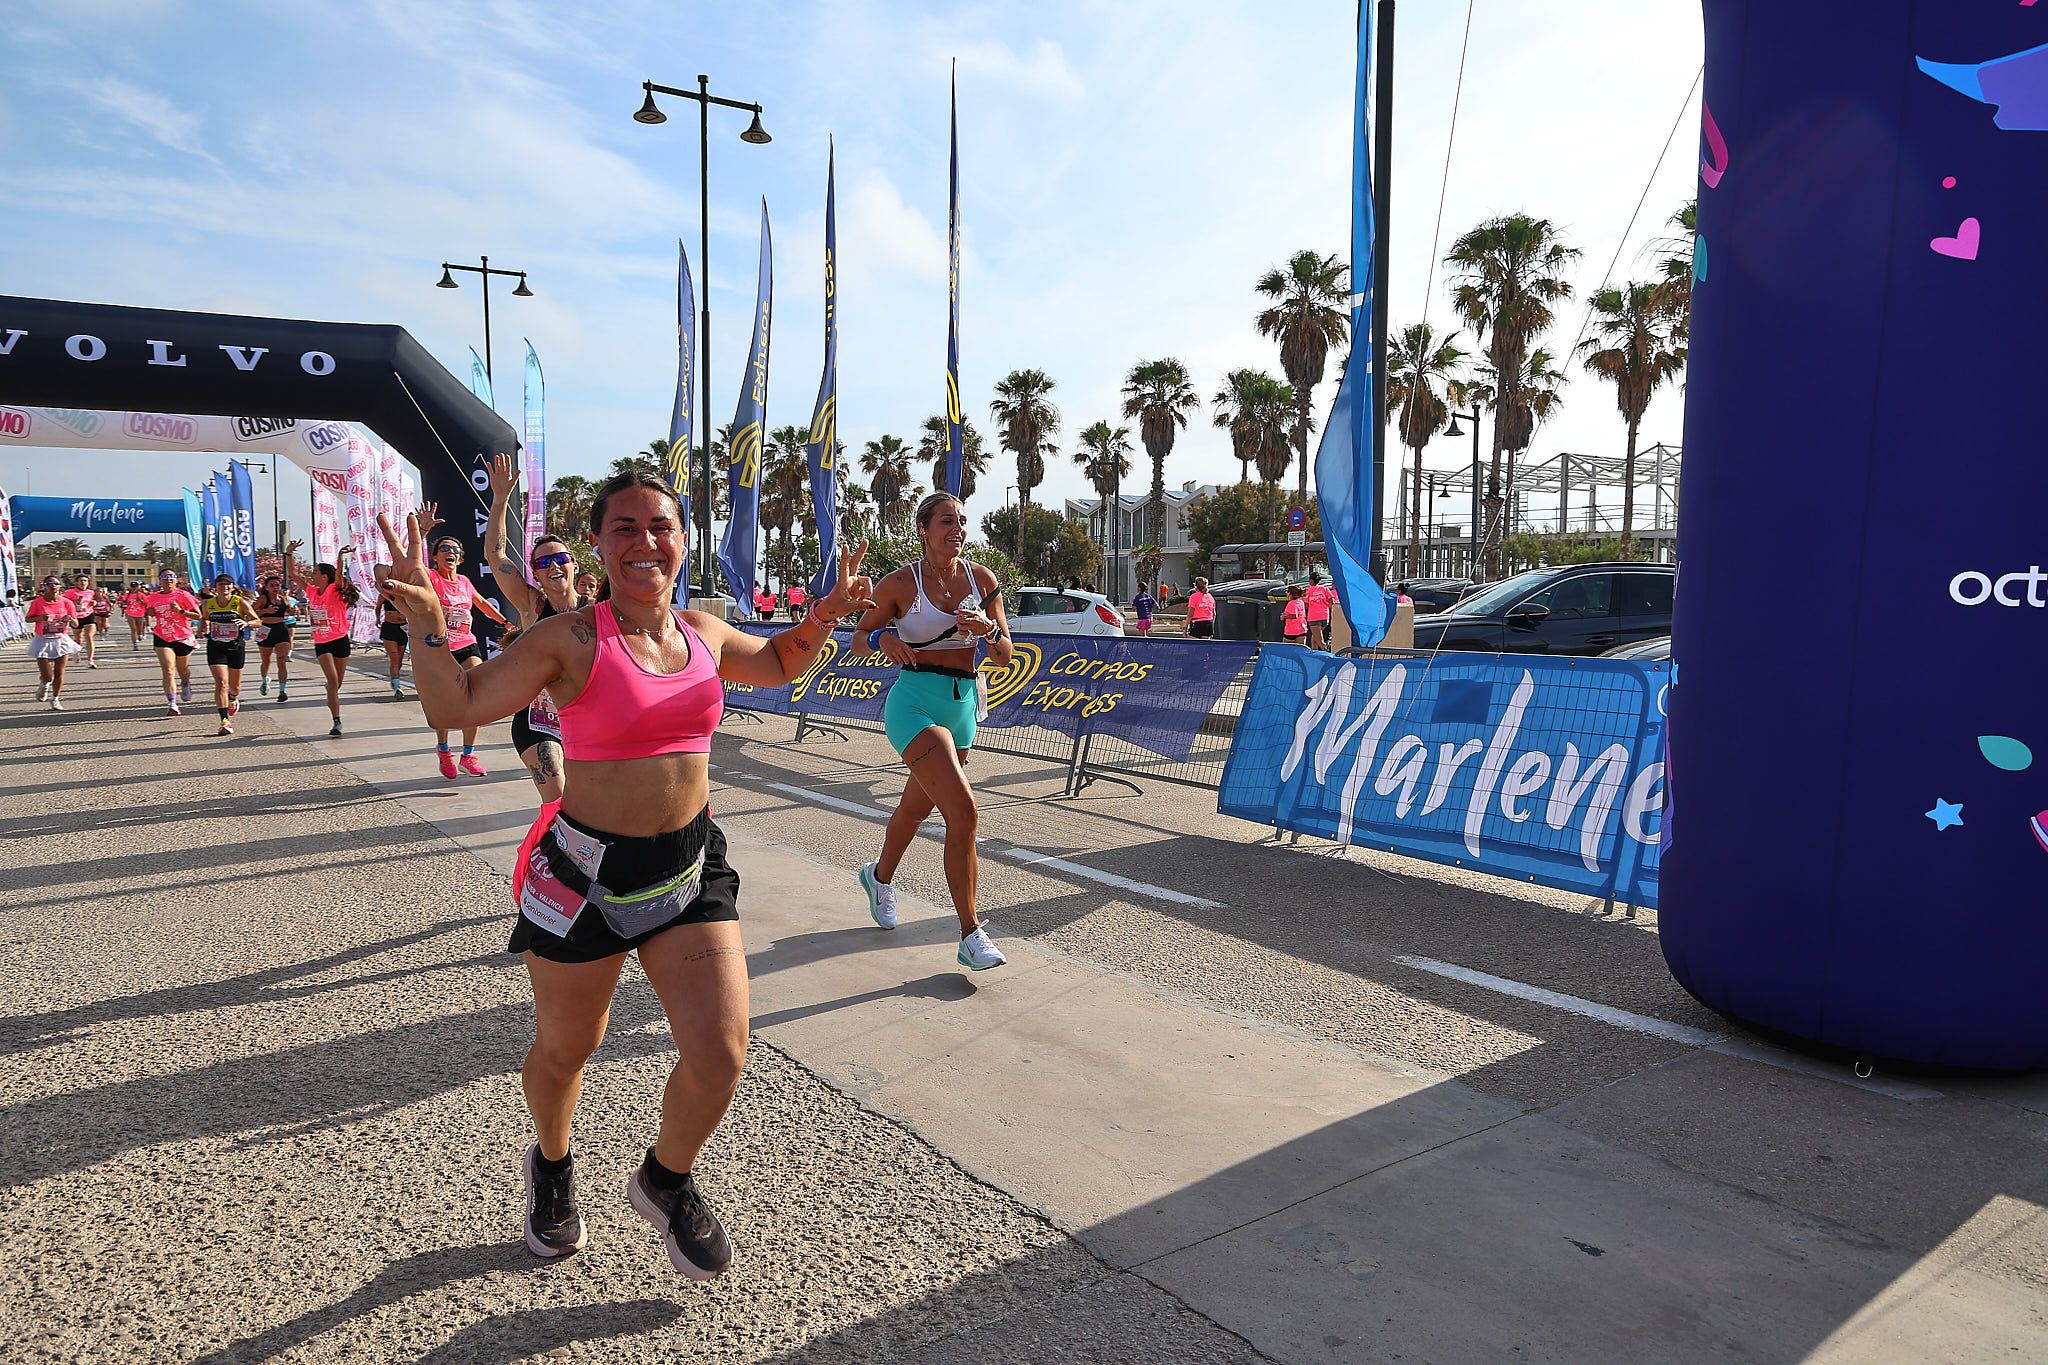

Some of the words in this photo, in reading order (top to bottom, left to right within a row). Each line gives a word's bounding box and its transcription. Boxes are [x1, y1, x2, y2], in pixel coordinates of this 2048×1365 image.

[130, 412, 193, 441] COSMO
[309, 421, 349, 450] COSM
[312, 470, 347, 491] COSM
[70, 501, 145, 529] Marlene
[1949, 565, 2048, 608] oct
[1050, 652, 1153, 682] Correos
[816, 672, 883, 702] Express
[1022, 680, 1124, 718] Express
[1280, 661, 1665, 873] Marlene
[525, 901, 557, 926] Santander
[538, 892, 565, 913] VALENCIA
